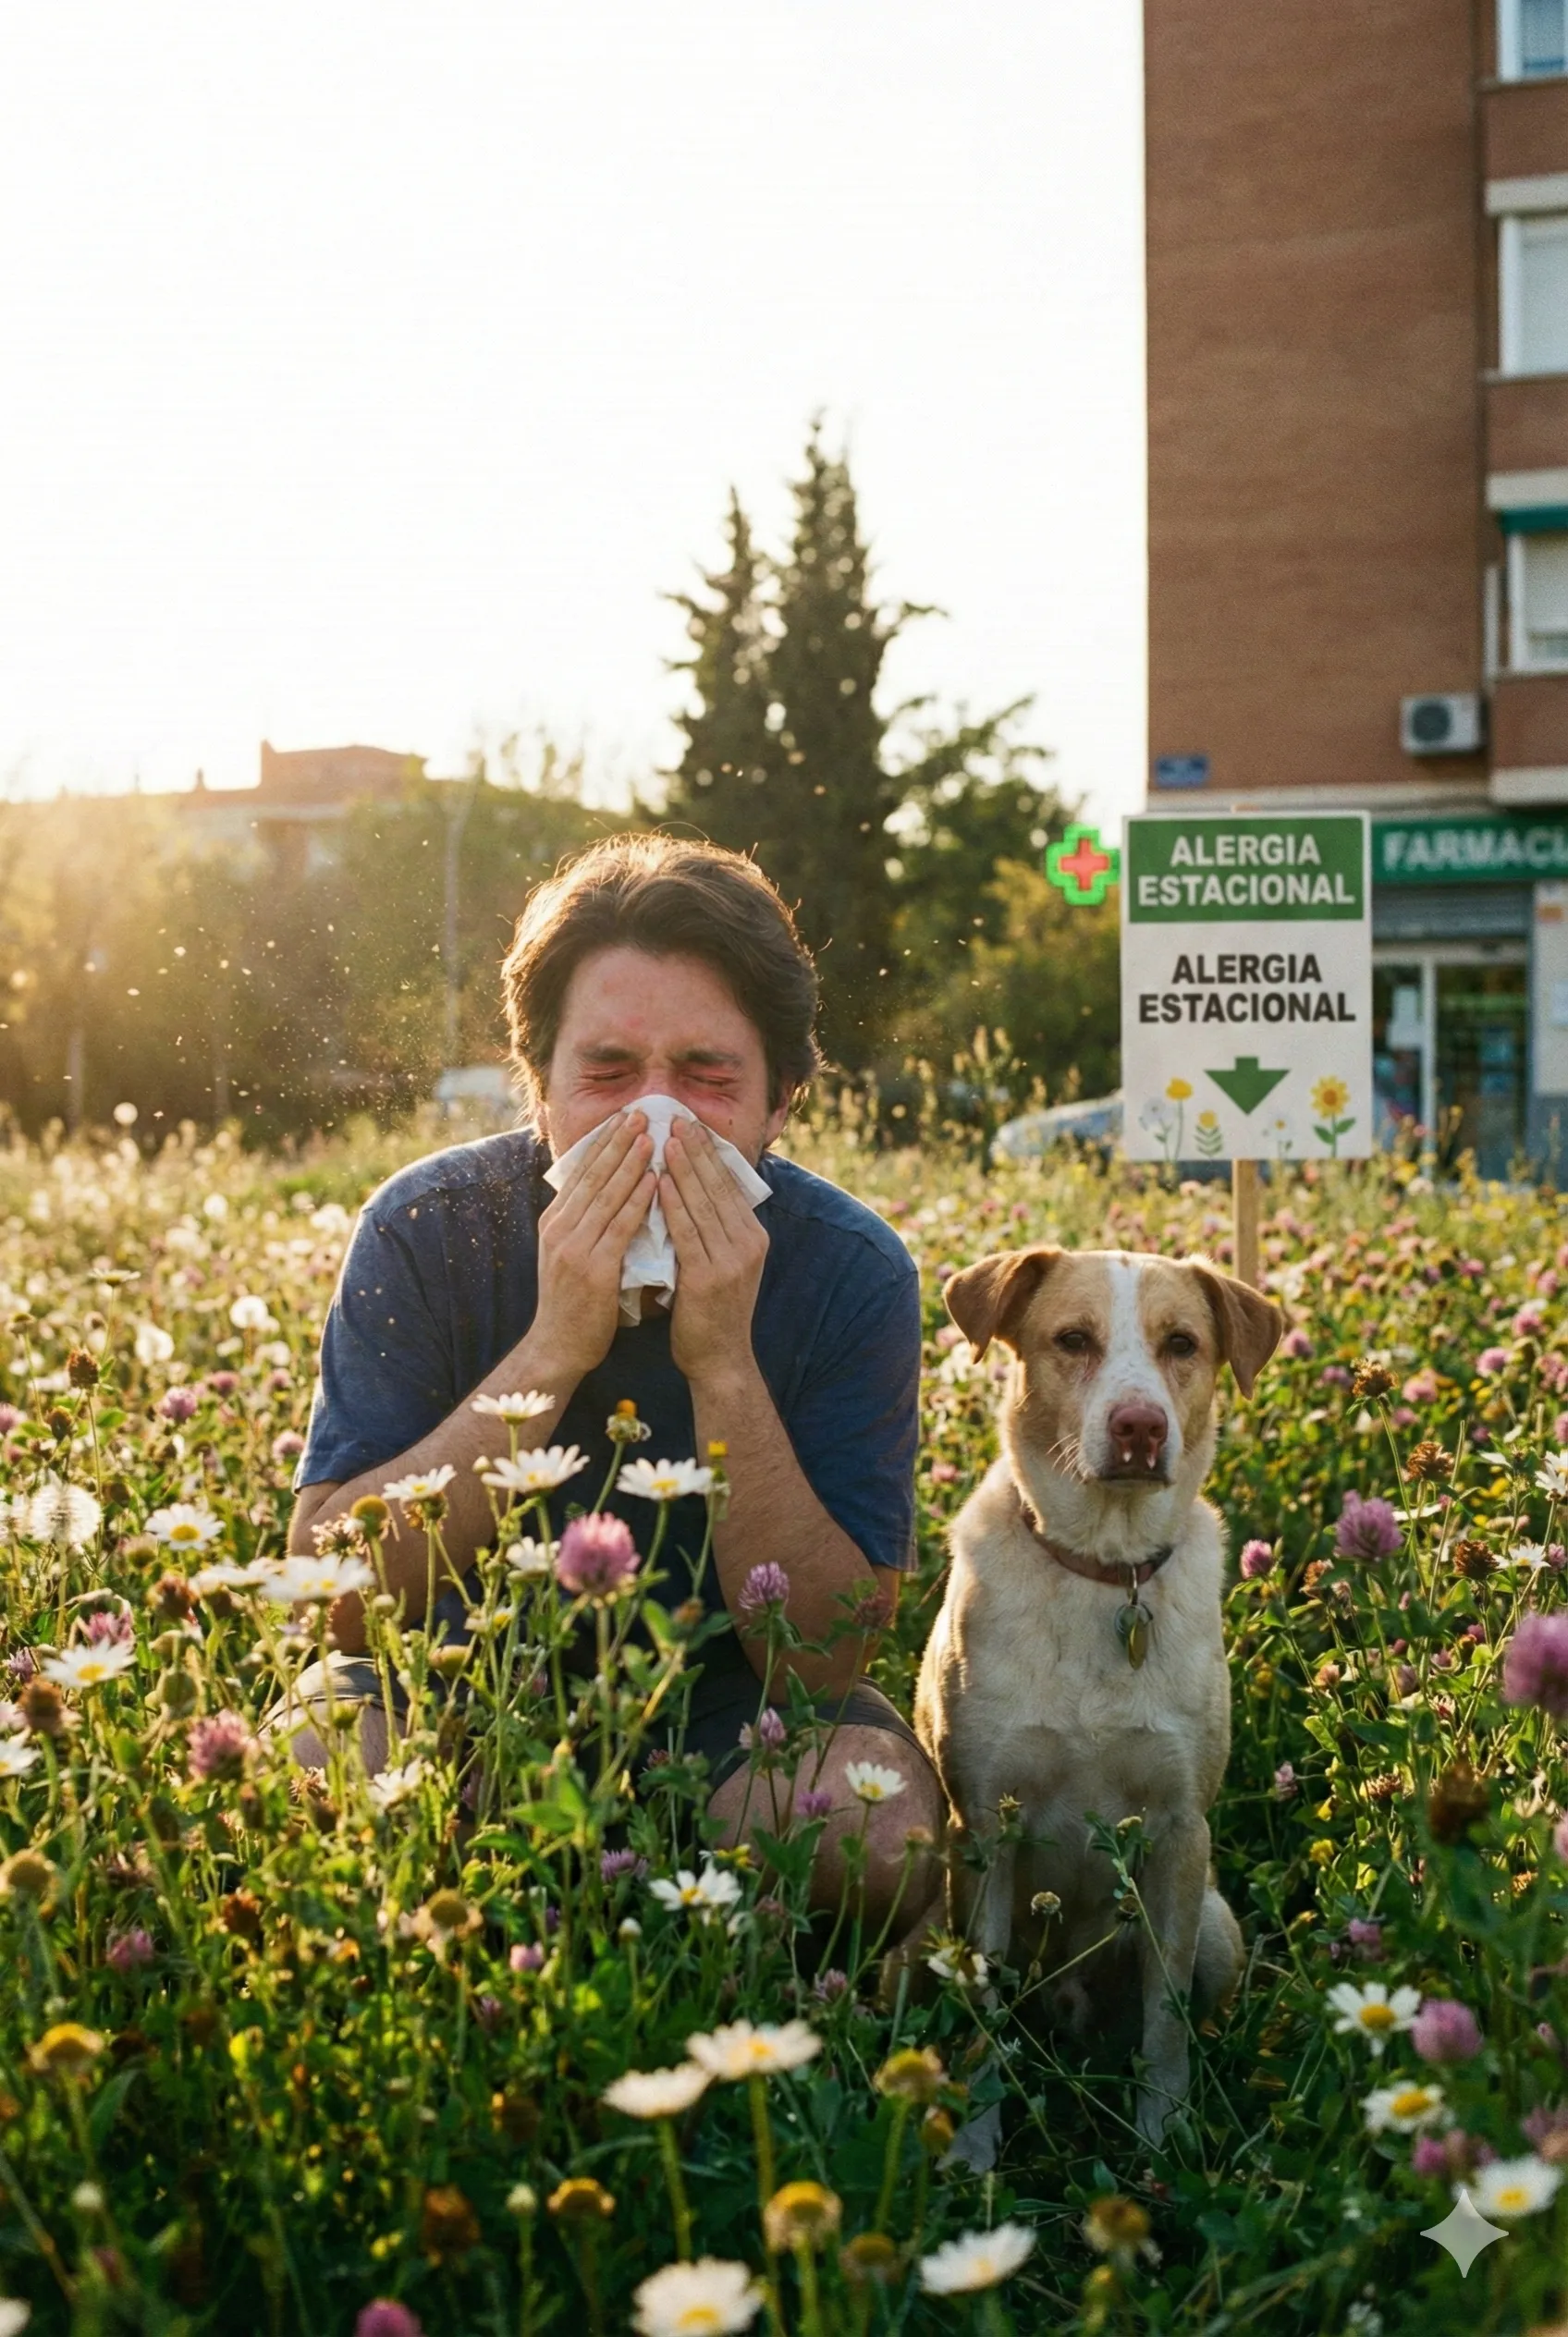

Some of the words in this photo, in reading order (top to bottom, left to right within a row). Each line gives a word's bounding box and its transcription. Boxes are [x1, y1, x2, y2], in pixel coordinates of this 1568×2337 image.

[1170, 834, 1321, 867] ALERGIA
[1383, 827, 1568, 870] FARMACI
[1137, 874, 1355, 906] ESTACIONAL
[1171, 953, 1323, 985] ALERGIA
[1138, 991, 1357, 1024] ESTACIONAL
